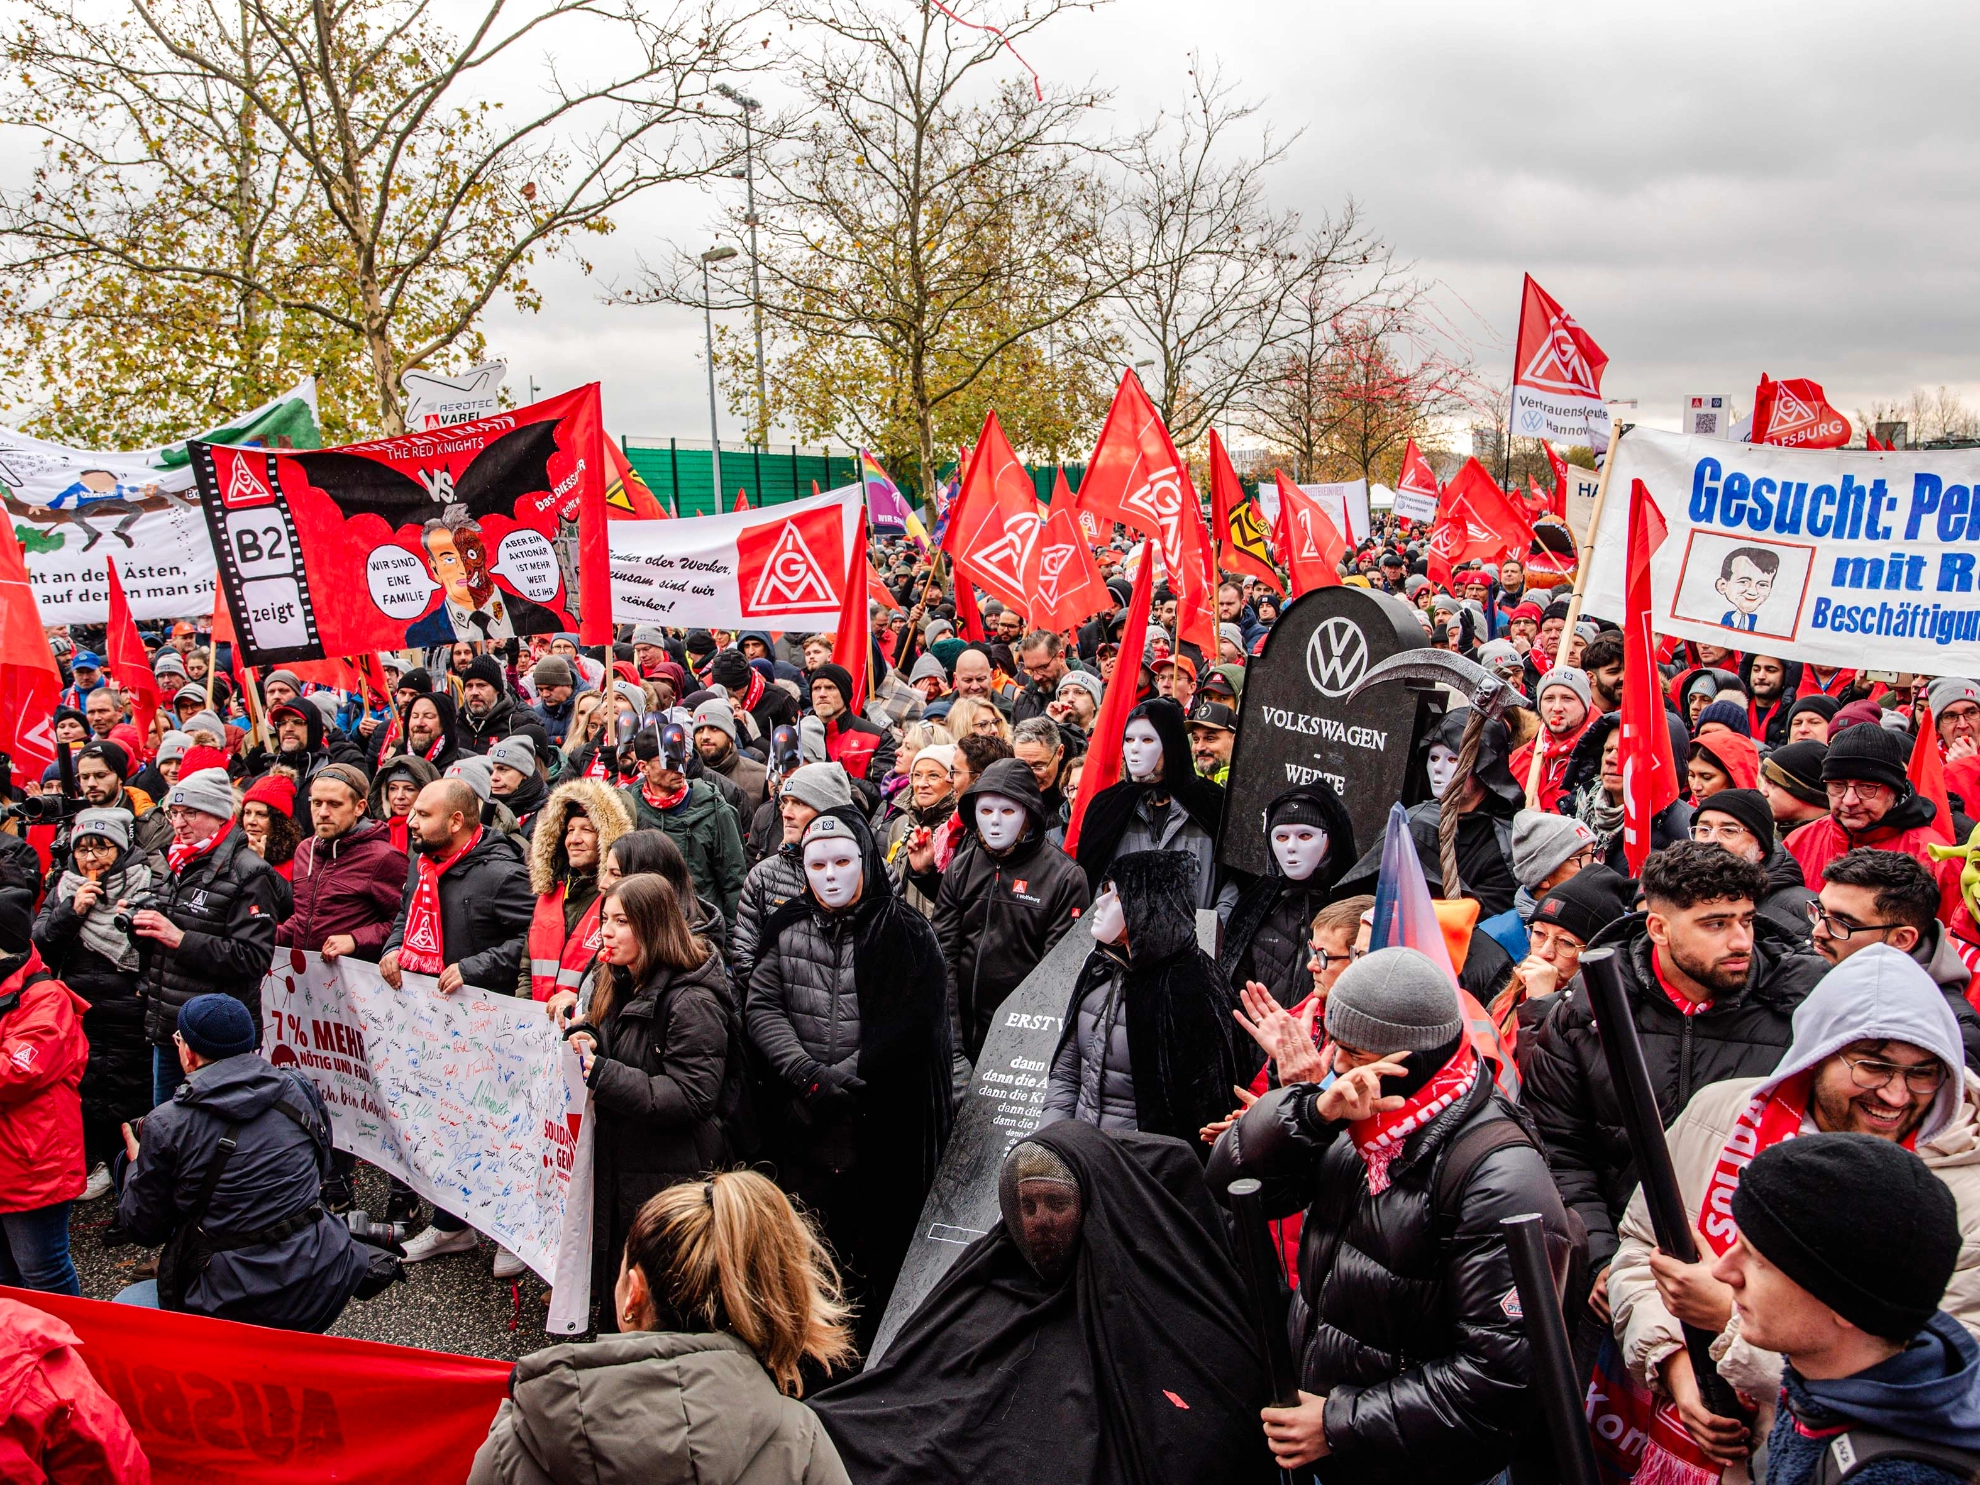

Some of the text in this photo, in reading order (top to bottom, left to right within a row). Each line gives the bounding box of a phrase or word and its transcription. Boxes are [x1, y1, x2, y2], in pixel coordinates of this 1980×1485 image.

[440, 399, 494, 413] AEROTEC
[1519, 395, 1608, 420] Vertrauensleute
[387, 437, 485, 460] THE RED KNIGHTS
[417, 467, 458, 504] VS.
[535, 494, 556, 512] Das
[1688, 457, 1898, 541] Gesucht:
[235, 526, 286, 564] B2
[505, 535, 543, 549] ABER EIN
[509, 546, 549, 560] AKTIONÄR
[53, 572, 76, 583] an
[125, 562, 187, 581] Ästen,
[370, 557, 417, 571] WIR SIND
[516, 560, 551, 572] IST MEHR
[645, 556, 675, 568] oder
[679, 557, 731, 575] Werker,
[756, 529, 832, 607] IGM
[1831, 552, 1980, 592] mit R
[388, 575, 411, 586] EINE
[526, 575, 547, 584] WERT
[659, 579, 687, 593] sind
[691, 584, 715, 597] wir
[42, 588, 73, 604] auf
[147, 585, 189, 599] man
[382, 591, 425, 605] FAMILIE
[528, 587, 554, 598] ALS IHR
[252, 602, 295, 624] zeigt
[620, 595, 675, 613] stärker!
[1262, 706, 1388, 751] VOLKSWAGEN
[1005, 1012, 1055, 1031] ERST
[312, 1019, 370, 1067] MEHR
[300, 1052, 333, 1070] NÖTIG
[334, 1058, 353, 1076] UND
[354, 1065, 372, 1084] FAIR
[1010, 1056, 1046, 1071] dann
[982, 1069, 1014, 1085] dann
[1015, 1072, 1036, 1087] die
[341, 1090, 359, 1109] bin
[979, 1085, 1008, 1099] dann
[1009, 1089, 1028, 1102] die
[997, 1102, 1043, 1118] dann die
[993, 1114, 1016, 1127] dann
[1017, 1117, 1034, 1129] die
